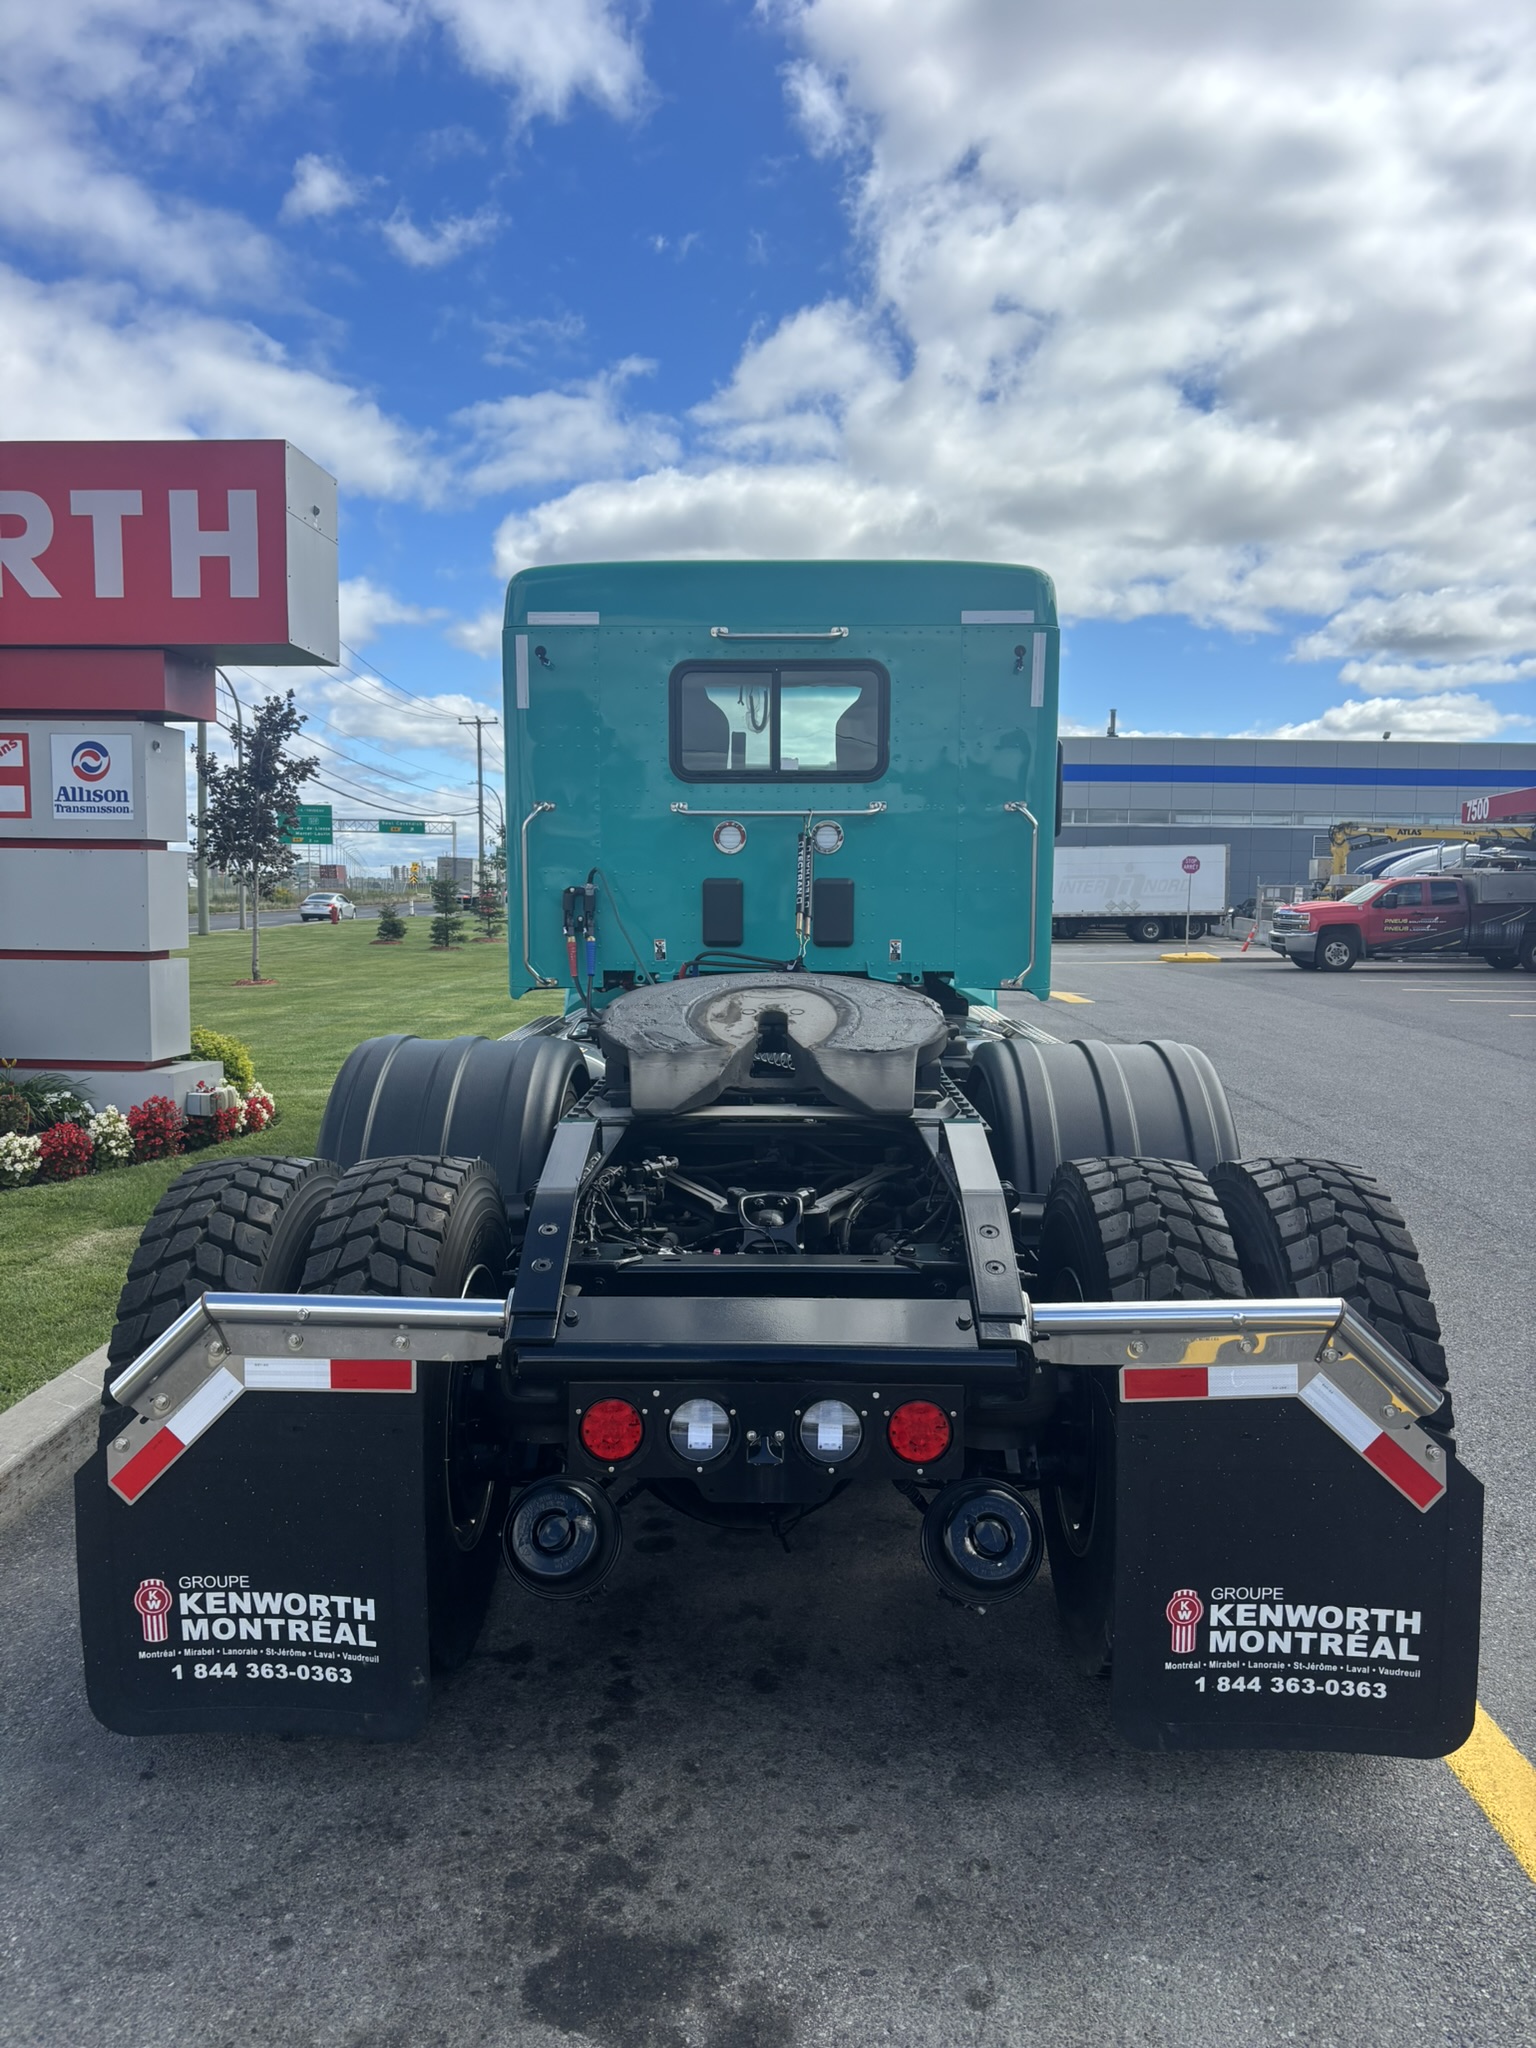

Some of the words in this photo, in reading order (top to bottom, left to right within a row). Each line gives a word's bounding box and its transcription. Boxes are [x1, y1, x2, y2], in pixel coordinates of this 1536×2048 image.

[0, 489, 259, 598] RTH
[54, 786, 130, 803] Allison
[54, 803, 131, 814] Transmission
[1466, 797, 1490, 822] 7500
[178, 1575, 250, 1589] GROUPE
[1211, 1587, 1284, 1600] GROUPE
[178, 1591, 376, 1621] KENWORTH
[1209, 1603, 1421, 1635] KENWORTH
[181, 1615, 377, 1648] MONTRÉAL
[138, 1649, 176, 1659] Montréal
[183, 1647, 215, 1656] Mirabel
[222, 1647, 258, 1656] Lanoraie
[265, 1647, 307, 1657] St-Jérôme
[313, 1650, 335, 1659] Laval
[342, 1651, 380, 1663] Vaudreuil
[1209, 1629, 1420, 1662] MONTRÉAL
[171, 1664, 183, 1680] 1
[194, 1663, 238, 1679] 844
[246, 1663, 353, 1684] 363-0363
[1164, 1661, 1201, 1670] Montréal
[1208, 1660, 1240, 1669] Mirabel
[1247, 1661, 1285, 1669] Lanoraie
[1293, 1661, 1338, 1672] St-Jérôme
[1346, 1664, 1370, 1674] Laval
[1378, 1666, 1421, 1678] Vaudreuil
[1195, 1676, 1206, 1693] 1
[1216, 1676, 1262, 1693] 844
[1270, 1677, 1388, 1699] 363-0363
